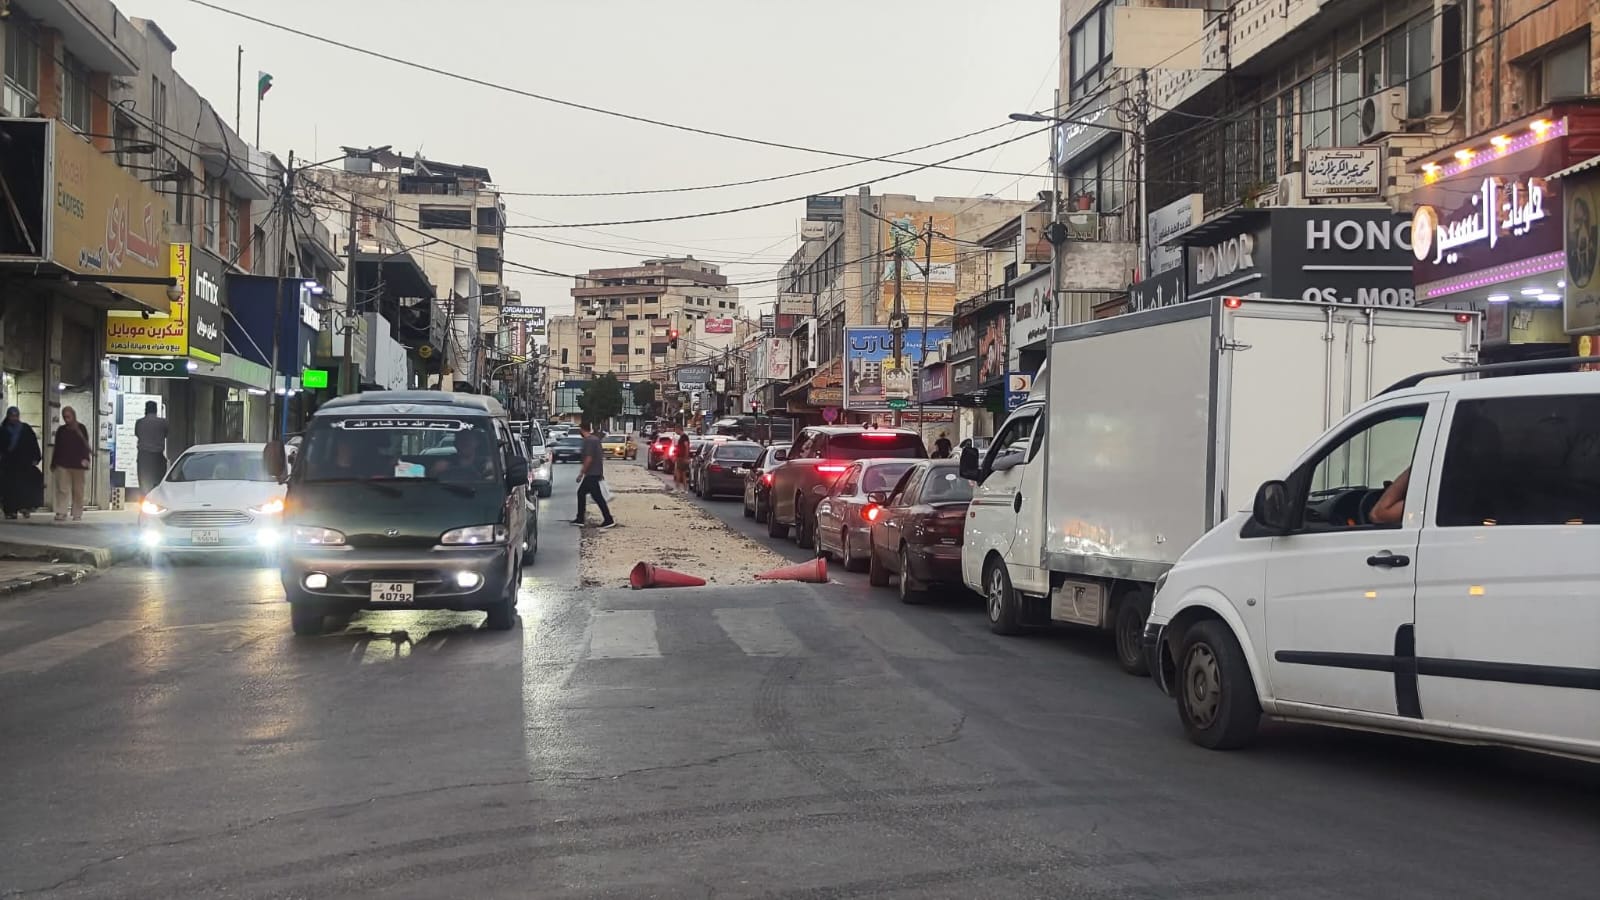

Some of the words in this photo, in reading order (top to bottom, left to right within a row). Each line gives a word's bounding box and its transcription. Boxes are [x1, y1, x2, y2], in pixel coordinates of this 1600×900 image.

[1320, 151, 1364, 161] الدكتور
[58, 182, 84, 220] Express
[1501, 177, 1545, 236] حلويات
[1432, 177, 1498, 265] النسيم
[1196, 233, 1254, 285] HONOR
[195, 268, 219, 306] Infinix
[1302, 287, 1337, 304] OS
[108, 323, 145, 338] موبايل
[148, 324, 183, 338] سكرين
[132, 362, 175, 371] oppo
[353, 419, 368, 428] الله
[372, 419, 394, 427] شاء
[411, 419, 425, 427] الله
[390, 584, 402, 592] 40
[380, 592, 412, 601] 40792
